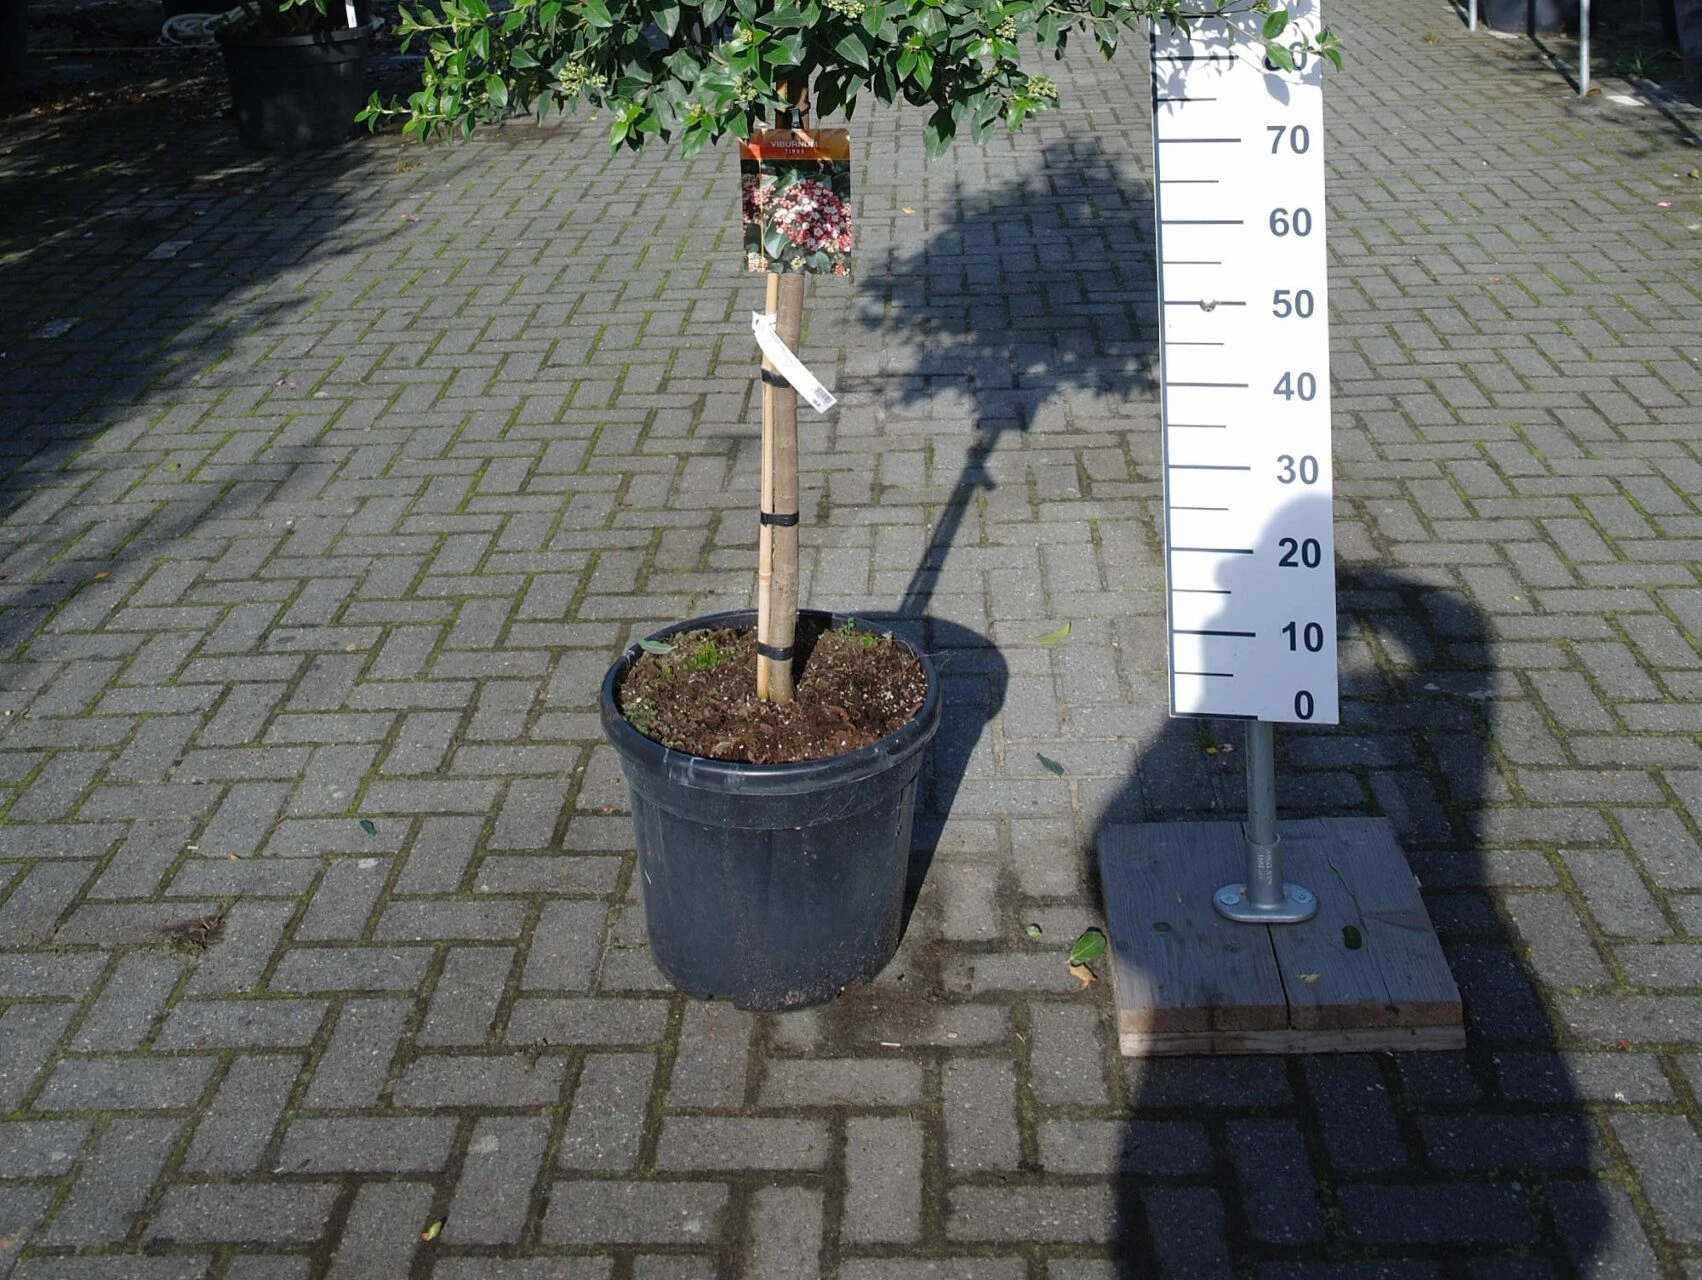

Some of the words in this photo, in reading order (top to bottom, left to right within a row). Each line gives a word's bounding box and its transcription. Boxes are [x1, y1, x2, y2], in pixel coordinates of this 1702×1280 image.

[1266, 125, 1310, 154] 70
[1269, 207, 1312, 237] 60
[1272, 289, 1314, 318] 50
[1273, 371, 1317, 401] 40
[1276, 454, 1319, 485] 30
[1278, 537, 1322, 568] 20
[1282, 621, 1324, 652] 10
[1294, 690, 1314, 720] 0
